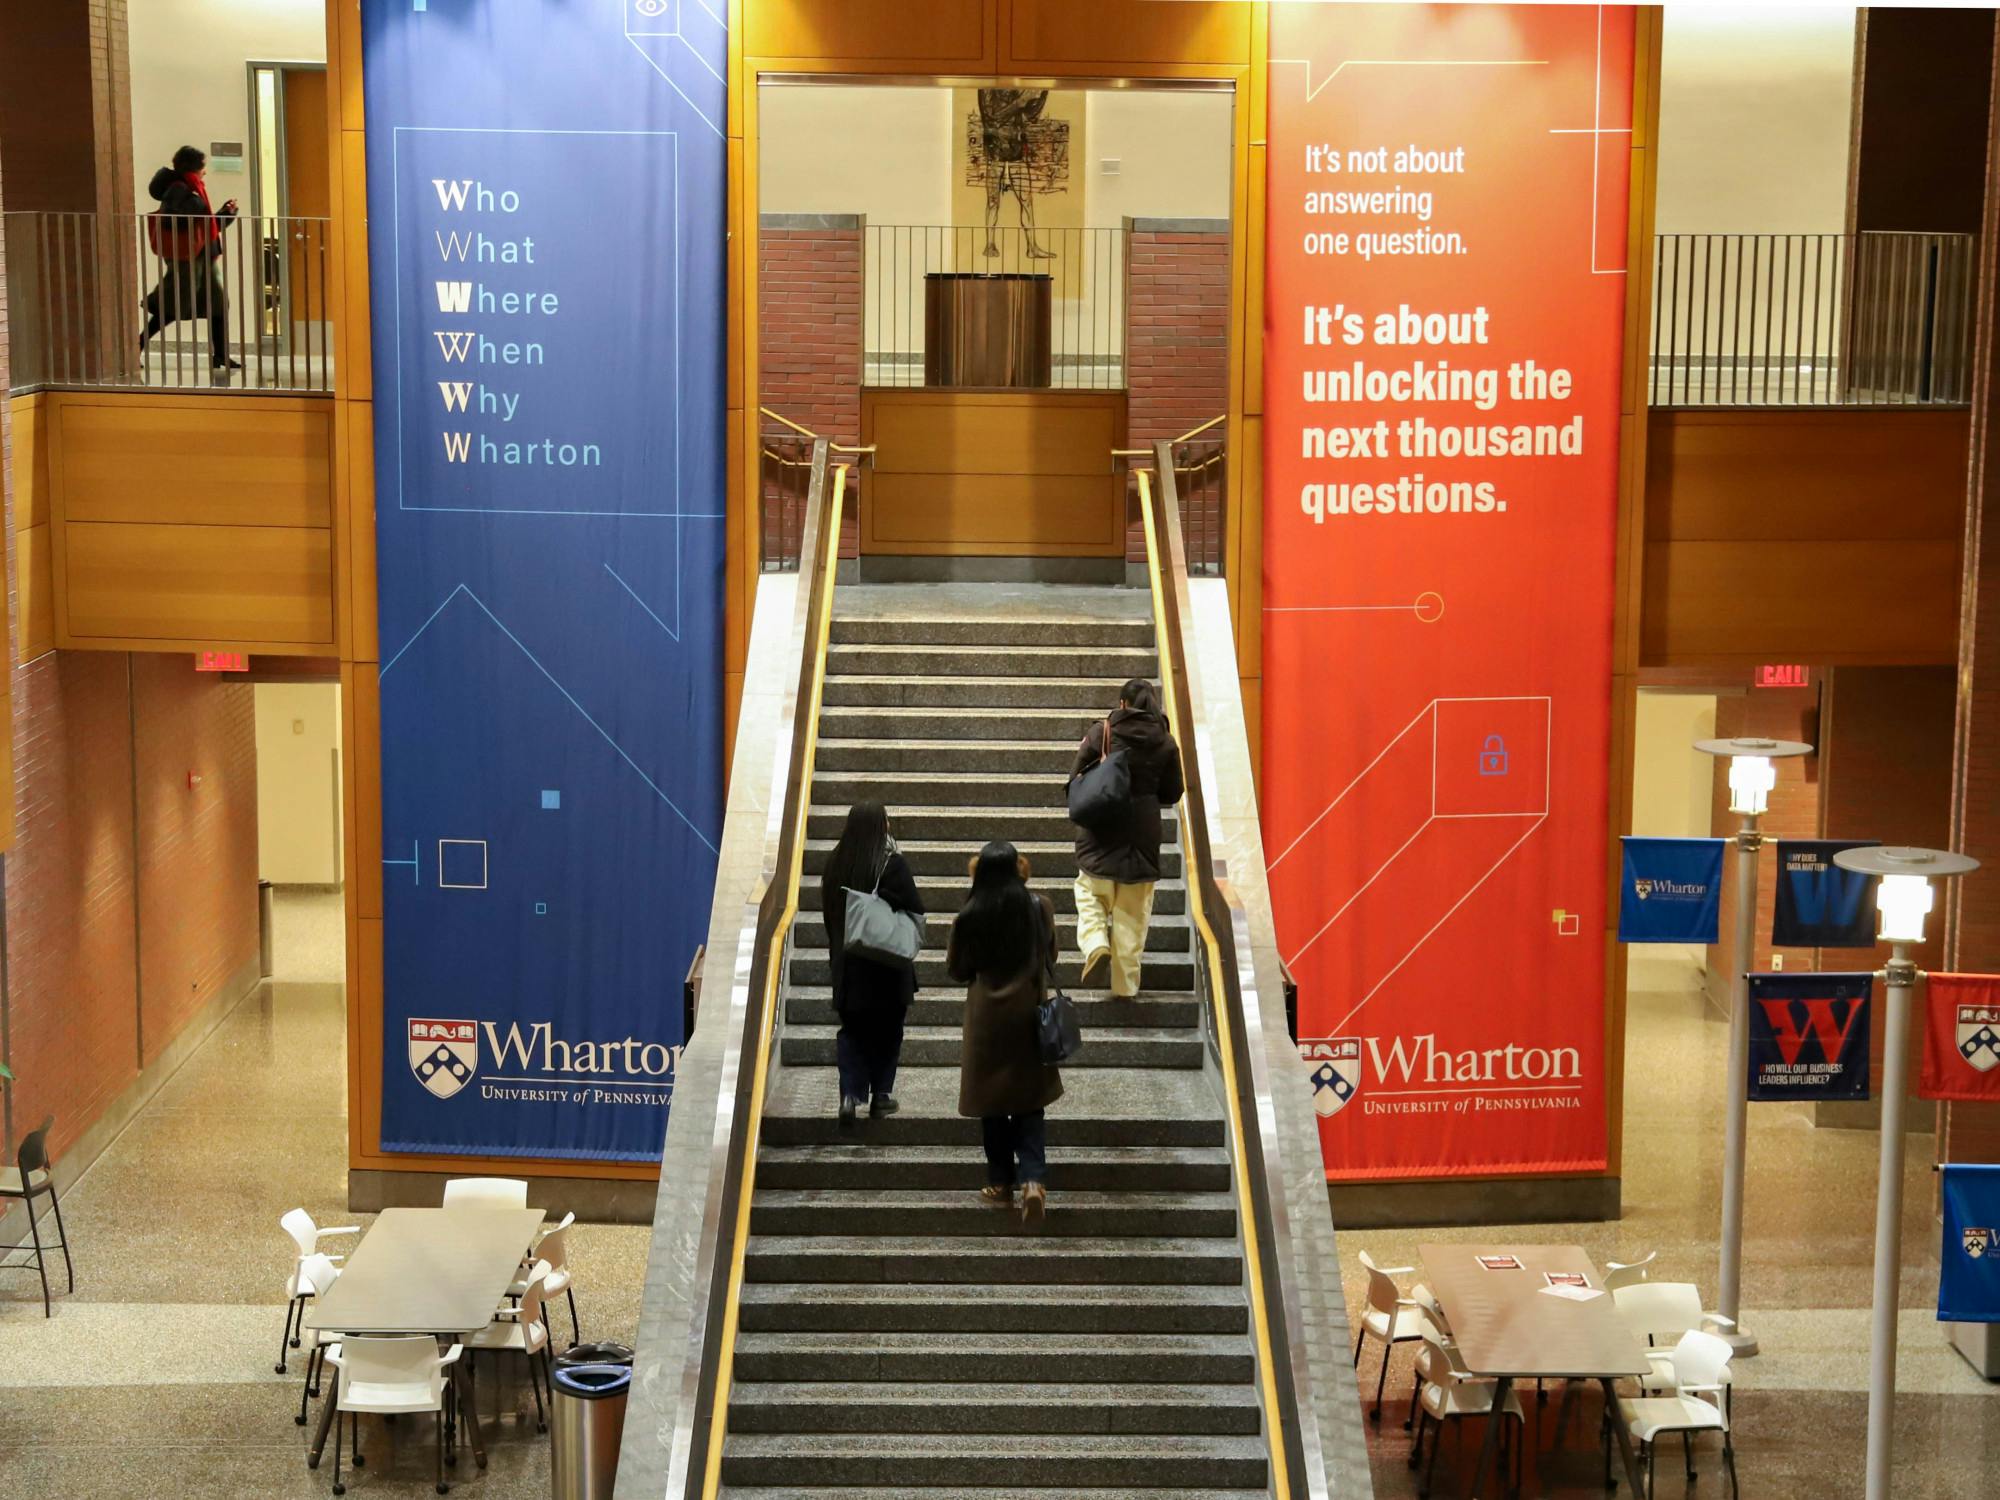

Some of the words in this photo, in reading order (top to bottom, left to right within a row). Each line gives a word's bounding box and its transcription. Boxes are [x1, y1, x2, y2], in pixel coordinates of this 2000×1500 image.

[1304, 143, 1341, 173] It's
[1347, 147, 1388, 173] not
[1393, 144, 1465, 173] about
[431, 179, 520, 213] Who
[1304, 185, 1433, 220] answering
[435, 230, 535, 264] What
[1303, 232, 1349, 255] one
[1355, 226, 1467, 261] question.
[435, 281, 559, 315] Where
[1304, 304, 1364, 345] It's
[1373, 304, 1489, 345] about
[433, 331, 544, 365] When
[437, 381, 520, 422] Why
[1302, 360, 1498, 411] unlocking
[1506, 359, 1572, 400] the
[443, 431, 601, 466] Wharton
[1302, 420, 1389, 458] next
[1396, 415, 1583, 457] thousand
[1301, 473, 1507, 524] questions.
[1763, 664, 1802, 684] EXIT
[1652, 879, 1707, 895] Wharton
[1757, 997, 1865, 1067] W
[1365, 1032, 1582, 1084] Wharton
[1776, 1063, 1792, 1074] WILL
[1793, 1063, 1808, 1073] OUR
[1809, 1063, 1843, 1073] BUSINESS
[481, 1085, 569, 1102] UNIVERSITY
[573, 1088, 591, 1106] of
[1759, 1074, 1788, 1085] LEADERS
[1789, 1074, 1830, 1085] INFLUENCE?
[1363, 1100, 1449, 1115] UNIVERSITY
[1454, 1097, 1470, 1114] of
[1474, 1096, 1581, 1111] PENNSYLVANIA
